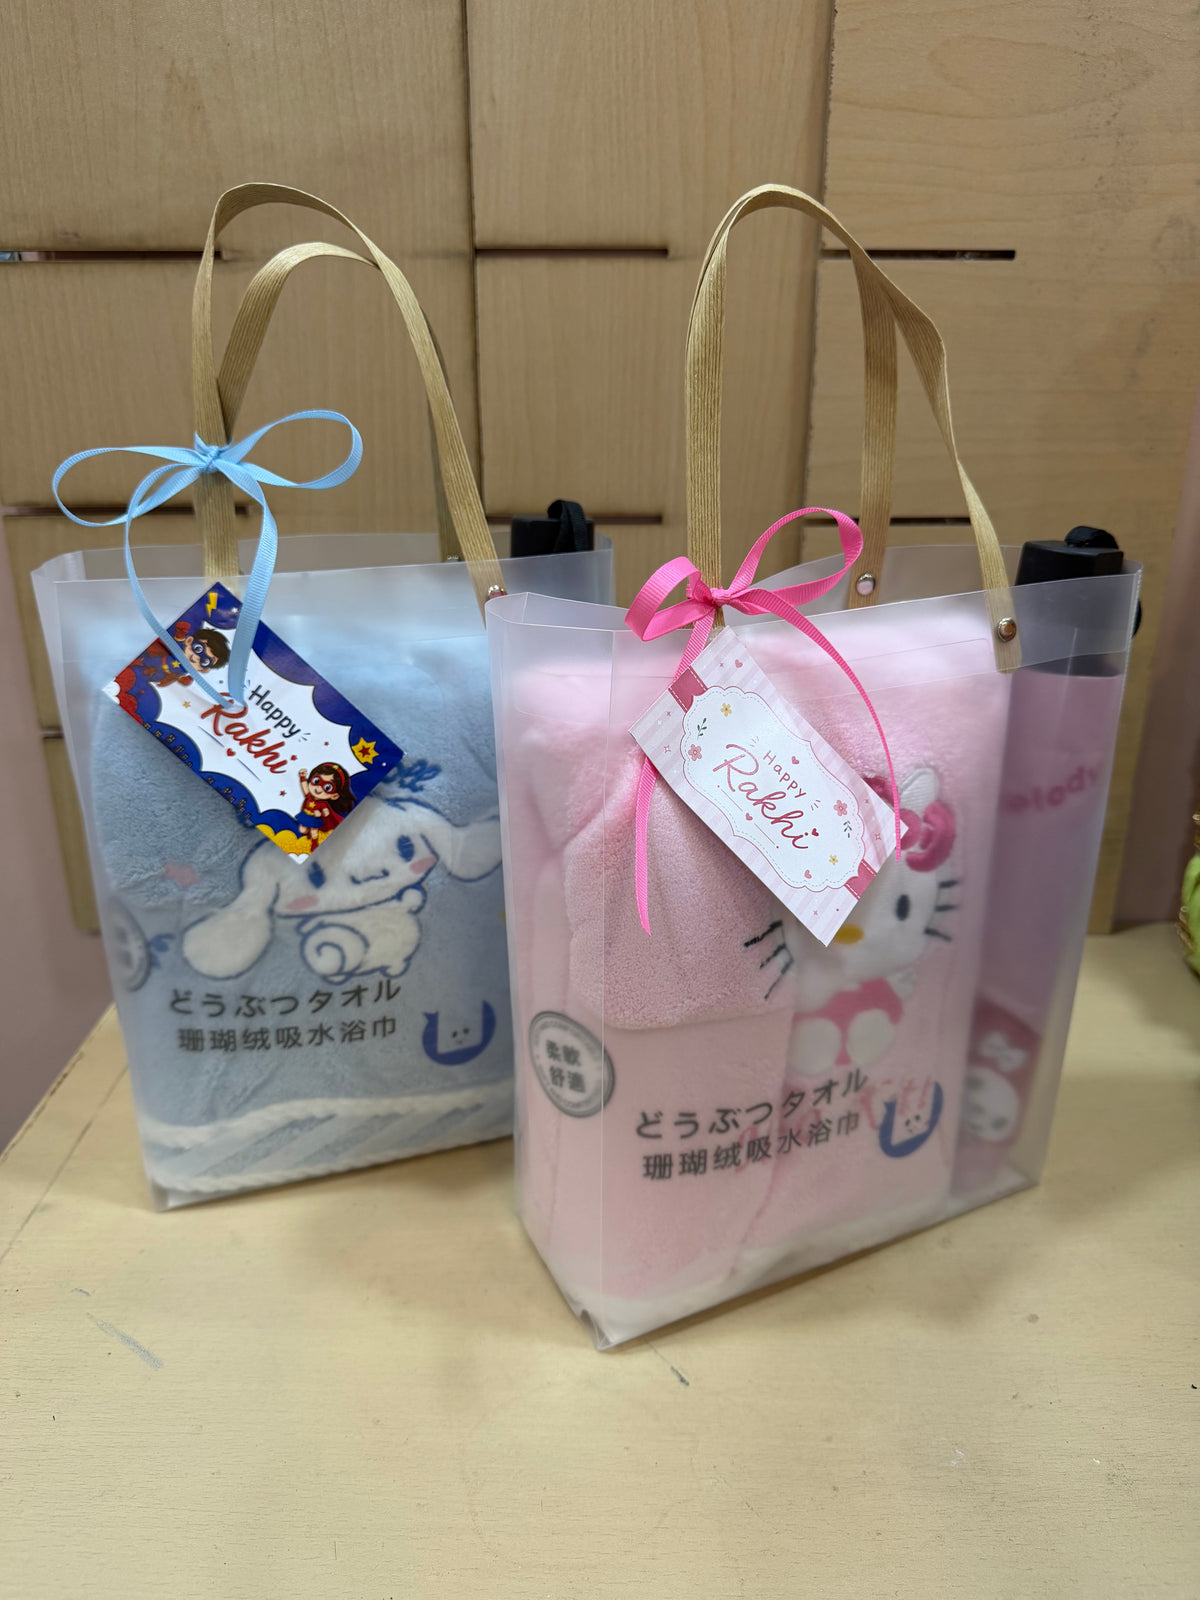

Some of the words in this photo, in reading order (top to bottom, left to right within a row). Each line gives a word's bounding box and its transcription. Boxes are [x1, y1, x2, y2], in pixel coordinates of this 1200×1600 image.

[201, 691, 298, 774] Rakhi
[248, 684, 301, 739] Happy
[712, 743, 809, 850] Rakhi
[763, 750, 807, 799] Happy
[169, 979, 401, 1018] どうぶつタオル
[177, 1015, 397, 1053] 珊瑚绒吸水浴巾
[635, 1067, 869, 1140] どうぶつタオル
[642, 1111, 860, 1181] 珊瑚绒吸水浴巾
